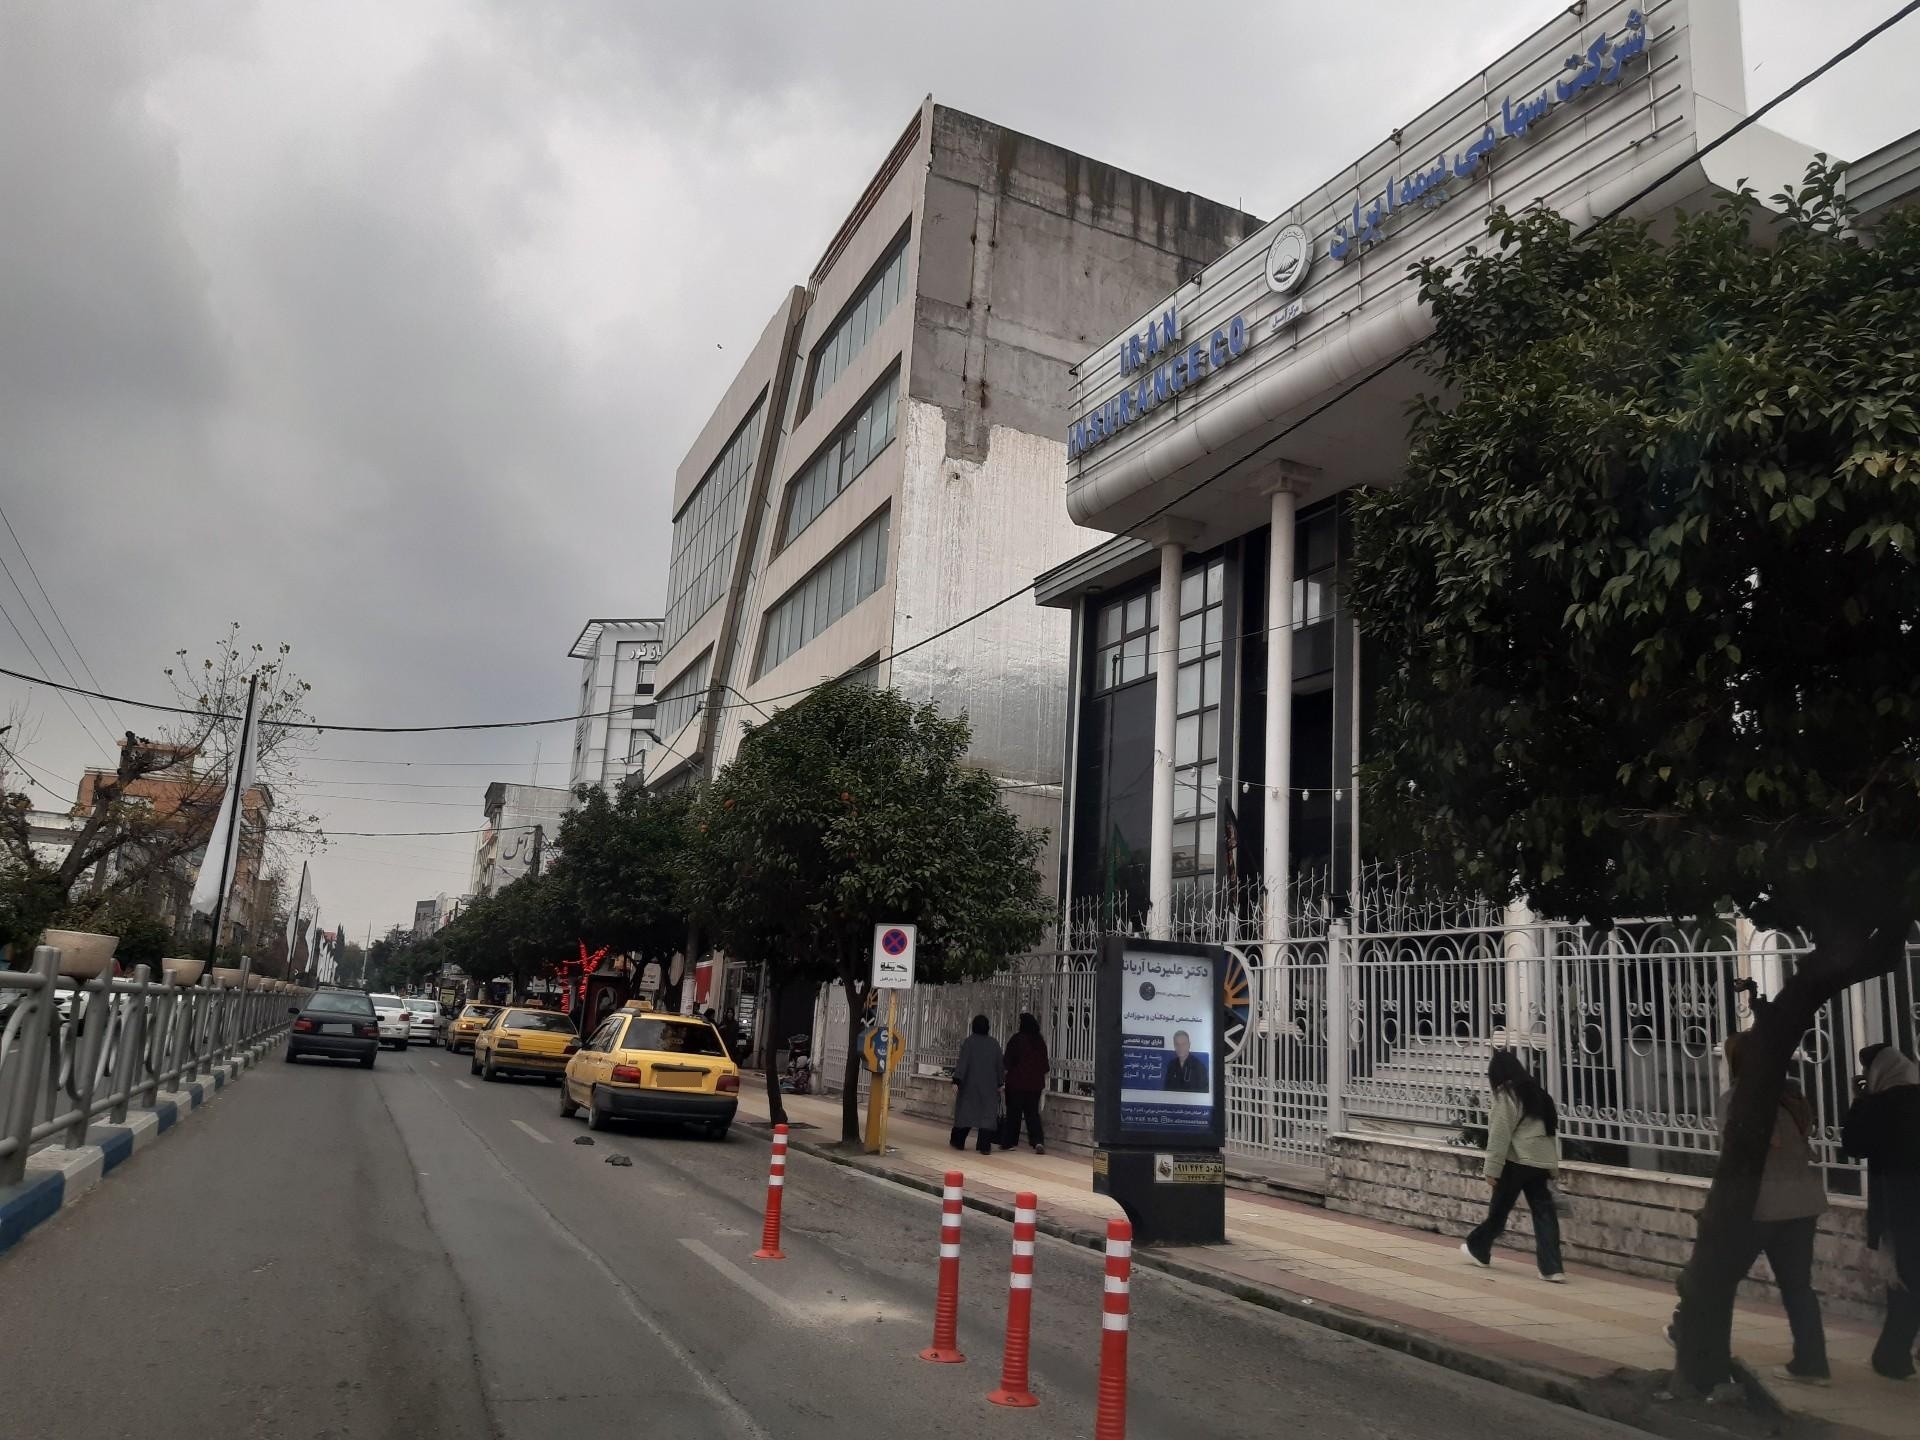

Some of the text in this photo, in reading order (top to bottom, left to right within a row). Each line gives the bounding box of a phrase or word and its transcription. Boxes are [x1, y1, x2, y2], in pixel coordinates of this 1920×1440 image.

[1329, 9, 1647, 262] شرکت سهامی بیمه ایران
[1119, 305, 1180, 378] IRAN
[1068, 315, 1248, 460] INSURANCE CO
[1147, 961, 1184, 978] علیرضا
[1184, 964, 1208, 979] دکتر
[1123, 1011, 1146, 1021] نوزادان
[1149, 1012, 1175, 1022] کودکان
